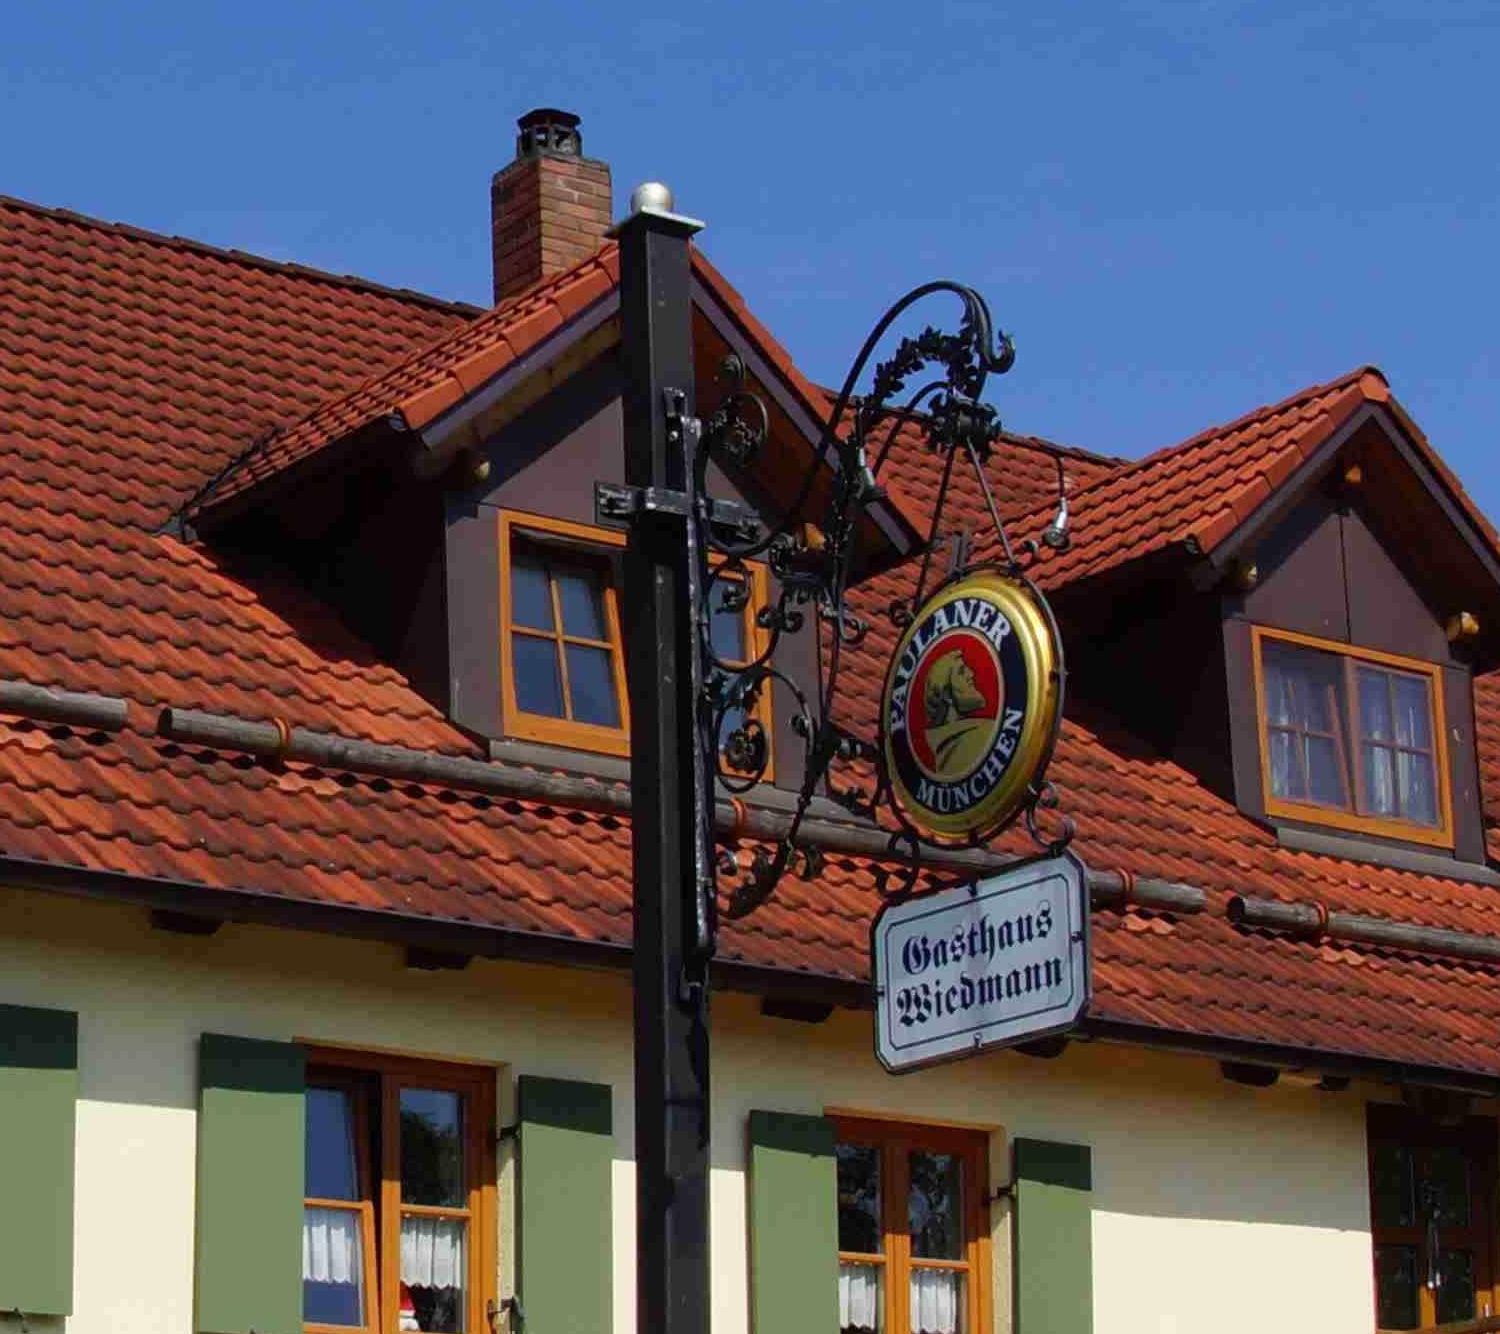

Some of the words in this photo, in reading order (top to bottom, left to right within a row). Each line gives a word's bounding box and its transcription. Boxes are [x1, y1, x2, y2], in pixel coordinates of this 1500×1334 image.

[890, 598, 1011, 731] PAULANER
[916, 705, 1023, 814] MÜNCHEN
[901, 900, 1053, 976] Gasthaus
[896, 954, 1063, 1027] Wiedmann
